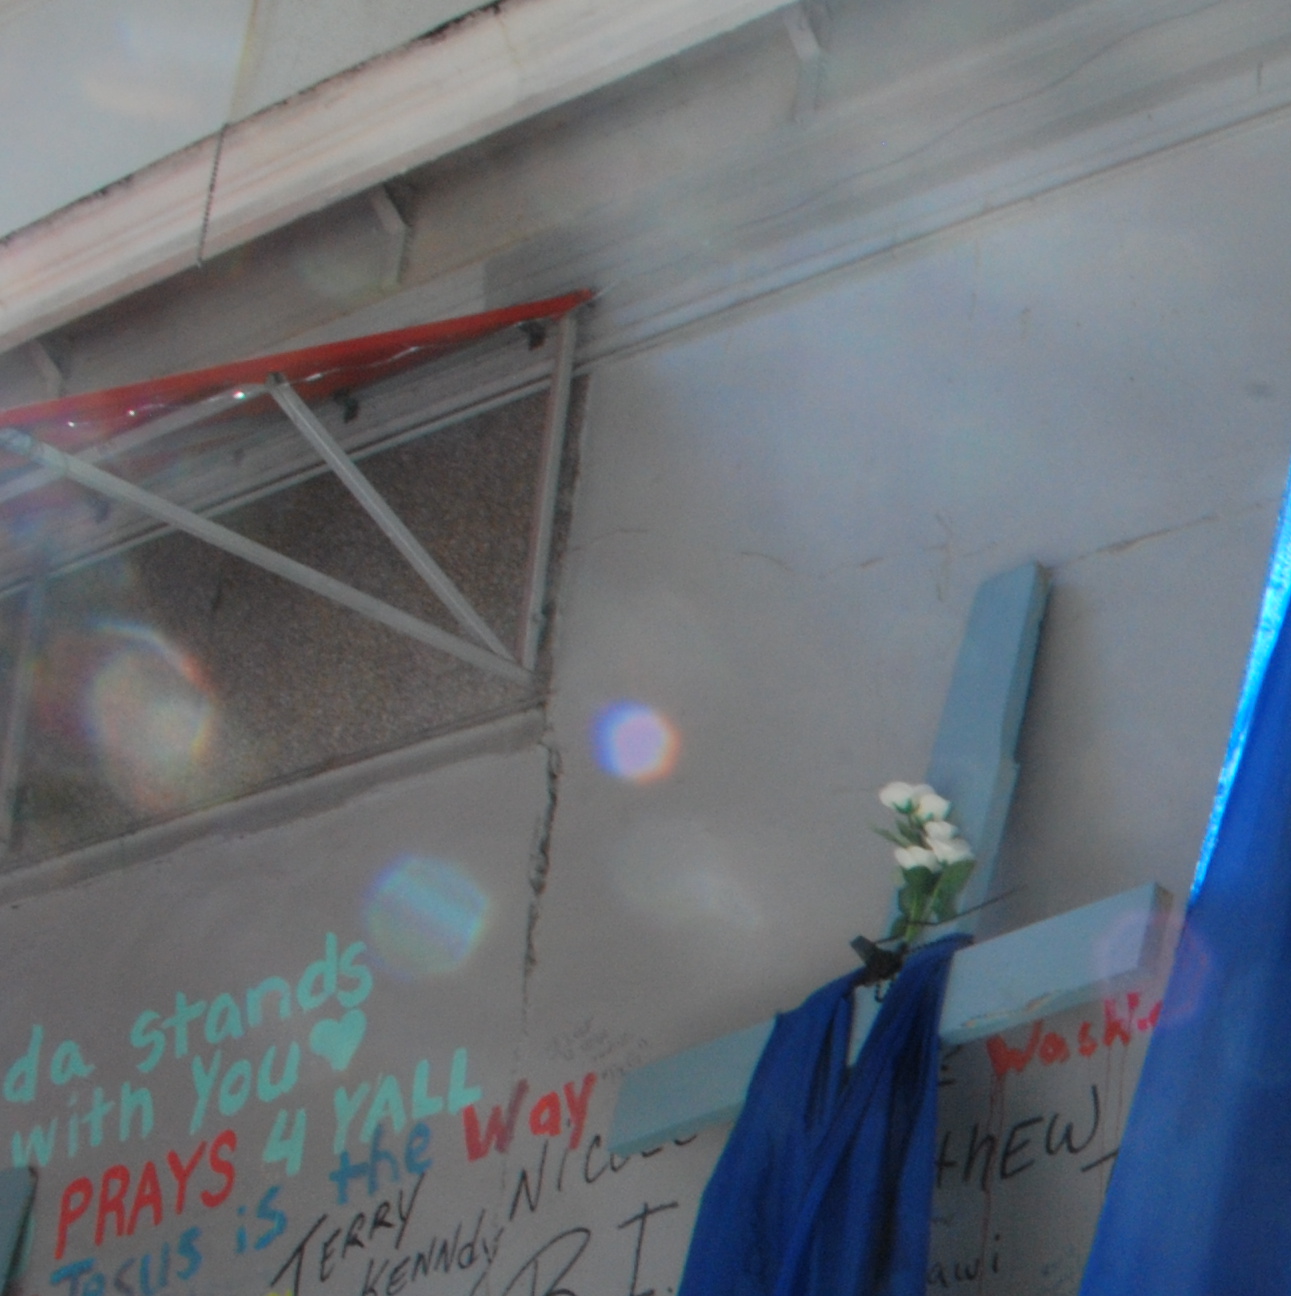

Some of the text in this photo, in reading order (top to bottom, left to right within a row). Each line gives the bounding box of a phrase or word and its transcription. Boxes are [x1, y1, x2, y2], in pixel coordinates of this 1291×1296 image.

[129, 931, 374, 1073] stands
[12, 1040, 300, 1168] with YOU
[54, 1130, 238, 1261] PRAYS
[262, 1108, 307, 1177] 4
[333, 1047, 482, 1155] YALL
[330, 1123, 432, 1205] the
[462, 1072, 597, 1161] Way
